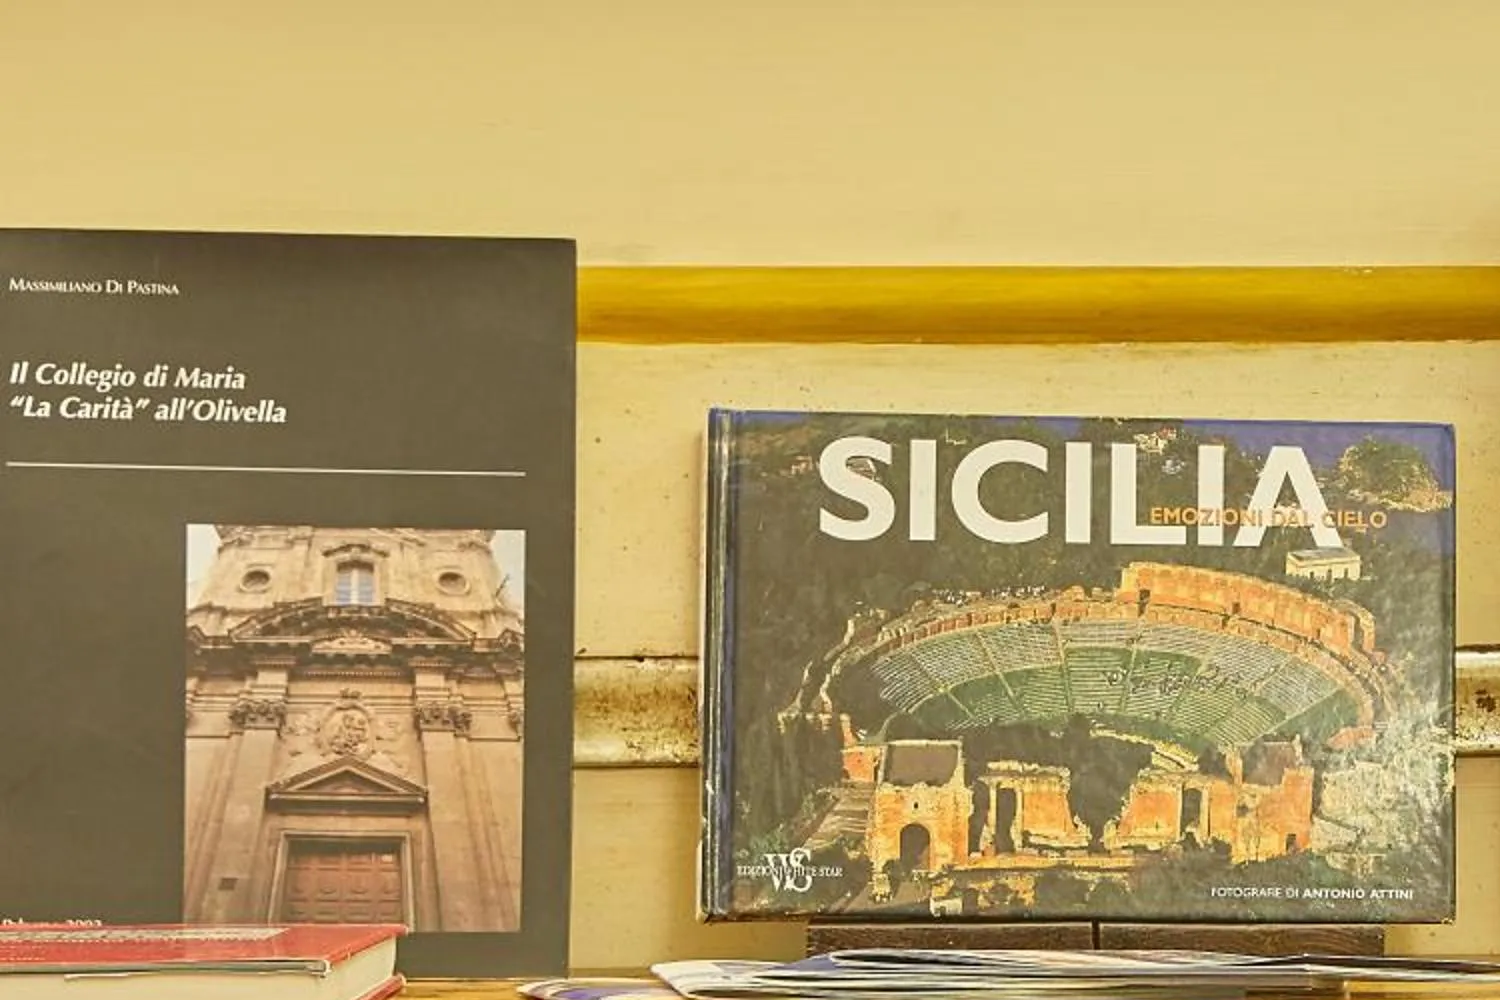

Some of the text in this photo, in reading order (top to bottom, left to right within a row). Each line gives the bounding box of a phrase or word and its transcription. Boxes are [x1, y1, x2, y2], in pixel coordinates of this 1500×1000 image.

[9, 361, 246, 393] Il Collegio di Maria
[818, 436, 1344, 549] SICILIA
[1150, 507, 1387, 529] EMOZIONI DAL CIELO
[1286, 888, 1299, 898] DI
[1302, 887, 1365, 899] ANTONIO
[1369, 888, 1413, 900] ATTINI
